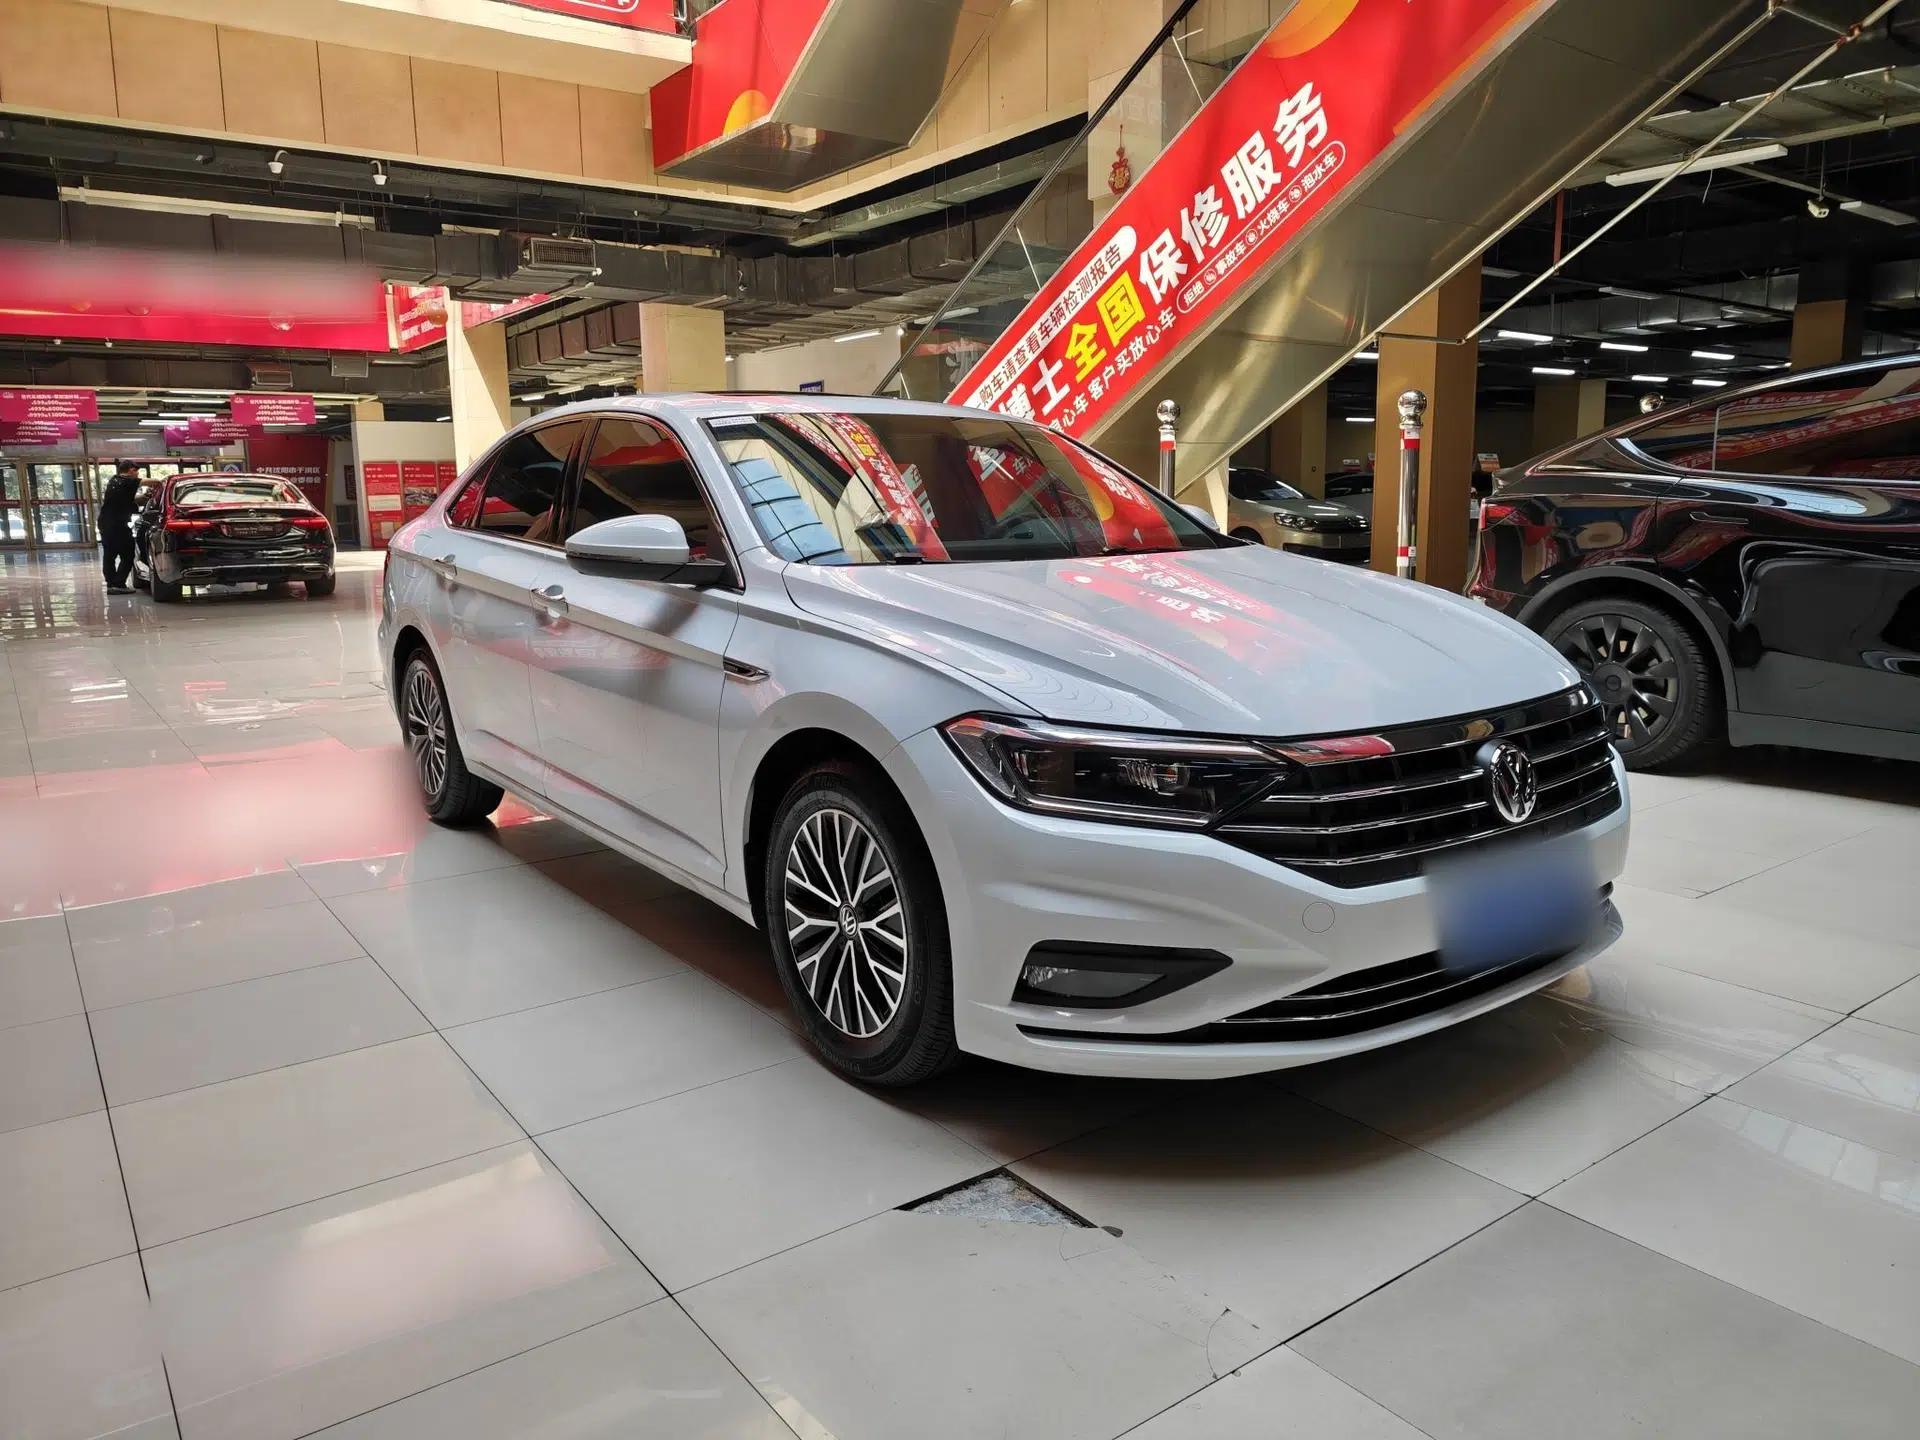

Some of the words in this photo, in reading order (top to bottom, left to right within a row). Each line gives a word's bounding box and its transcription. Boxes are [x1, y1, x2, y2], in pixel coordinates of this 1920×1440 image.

[1183, 282, 1205, 306] 拒绝
[1257, 198, 1290, 235] 火烧车
[1301, 151, 1337, 192] 泡水车
[976, 244, 1121, 408] 购车请查看车辆检测报告
[1087, 306, 1177, 401] 客户买放心车
